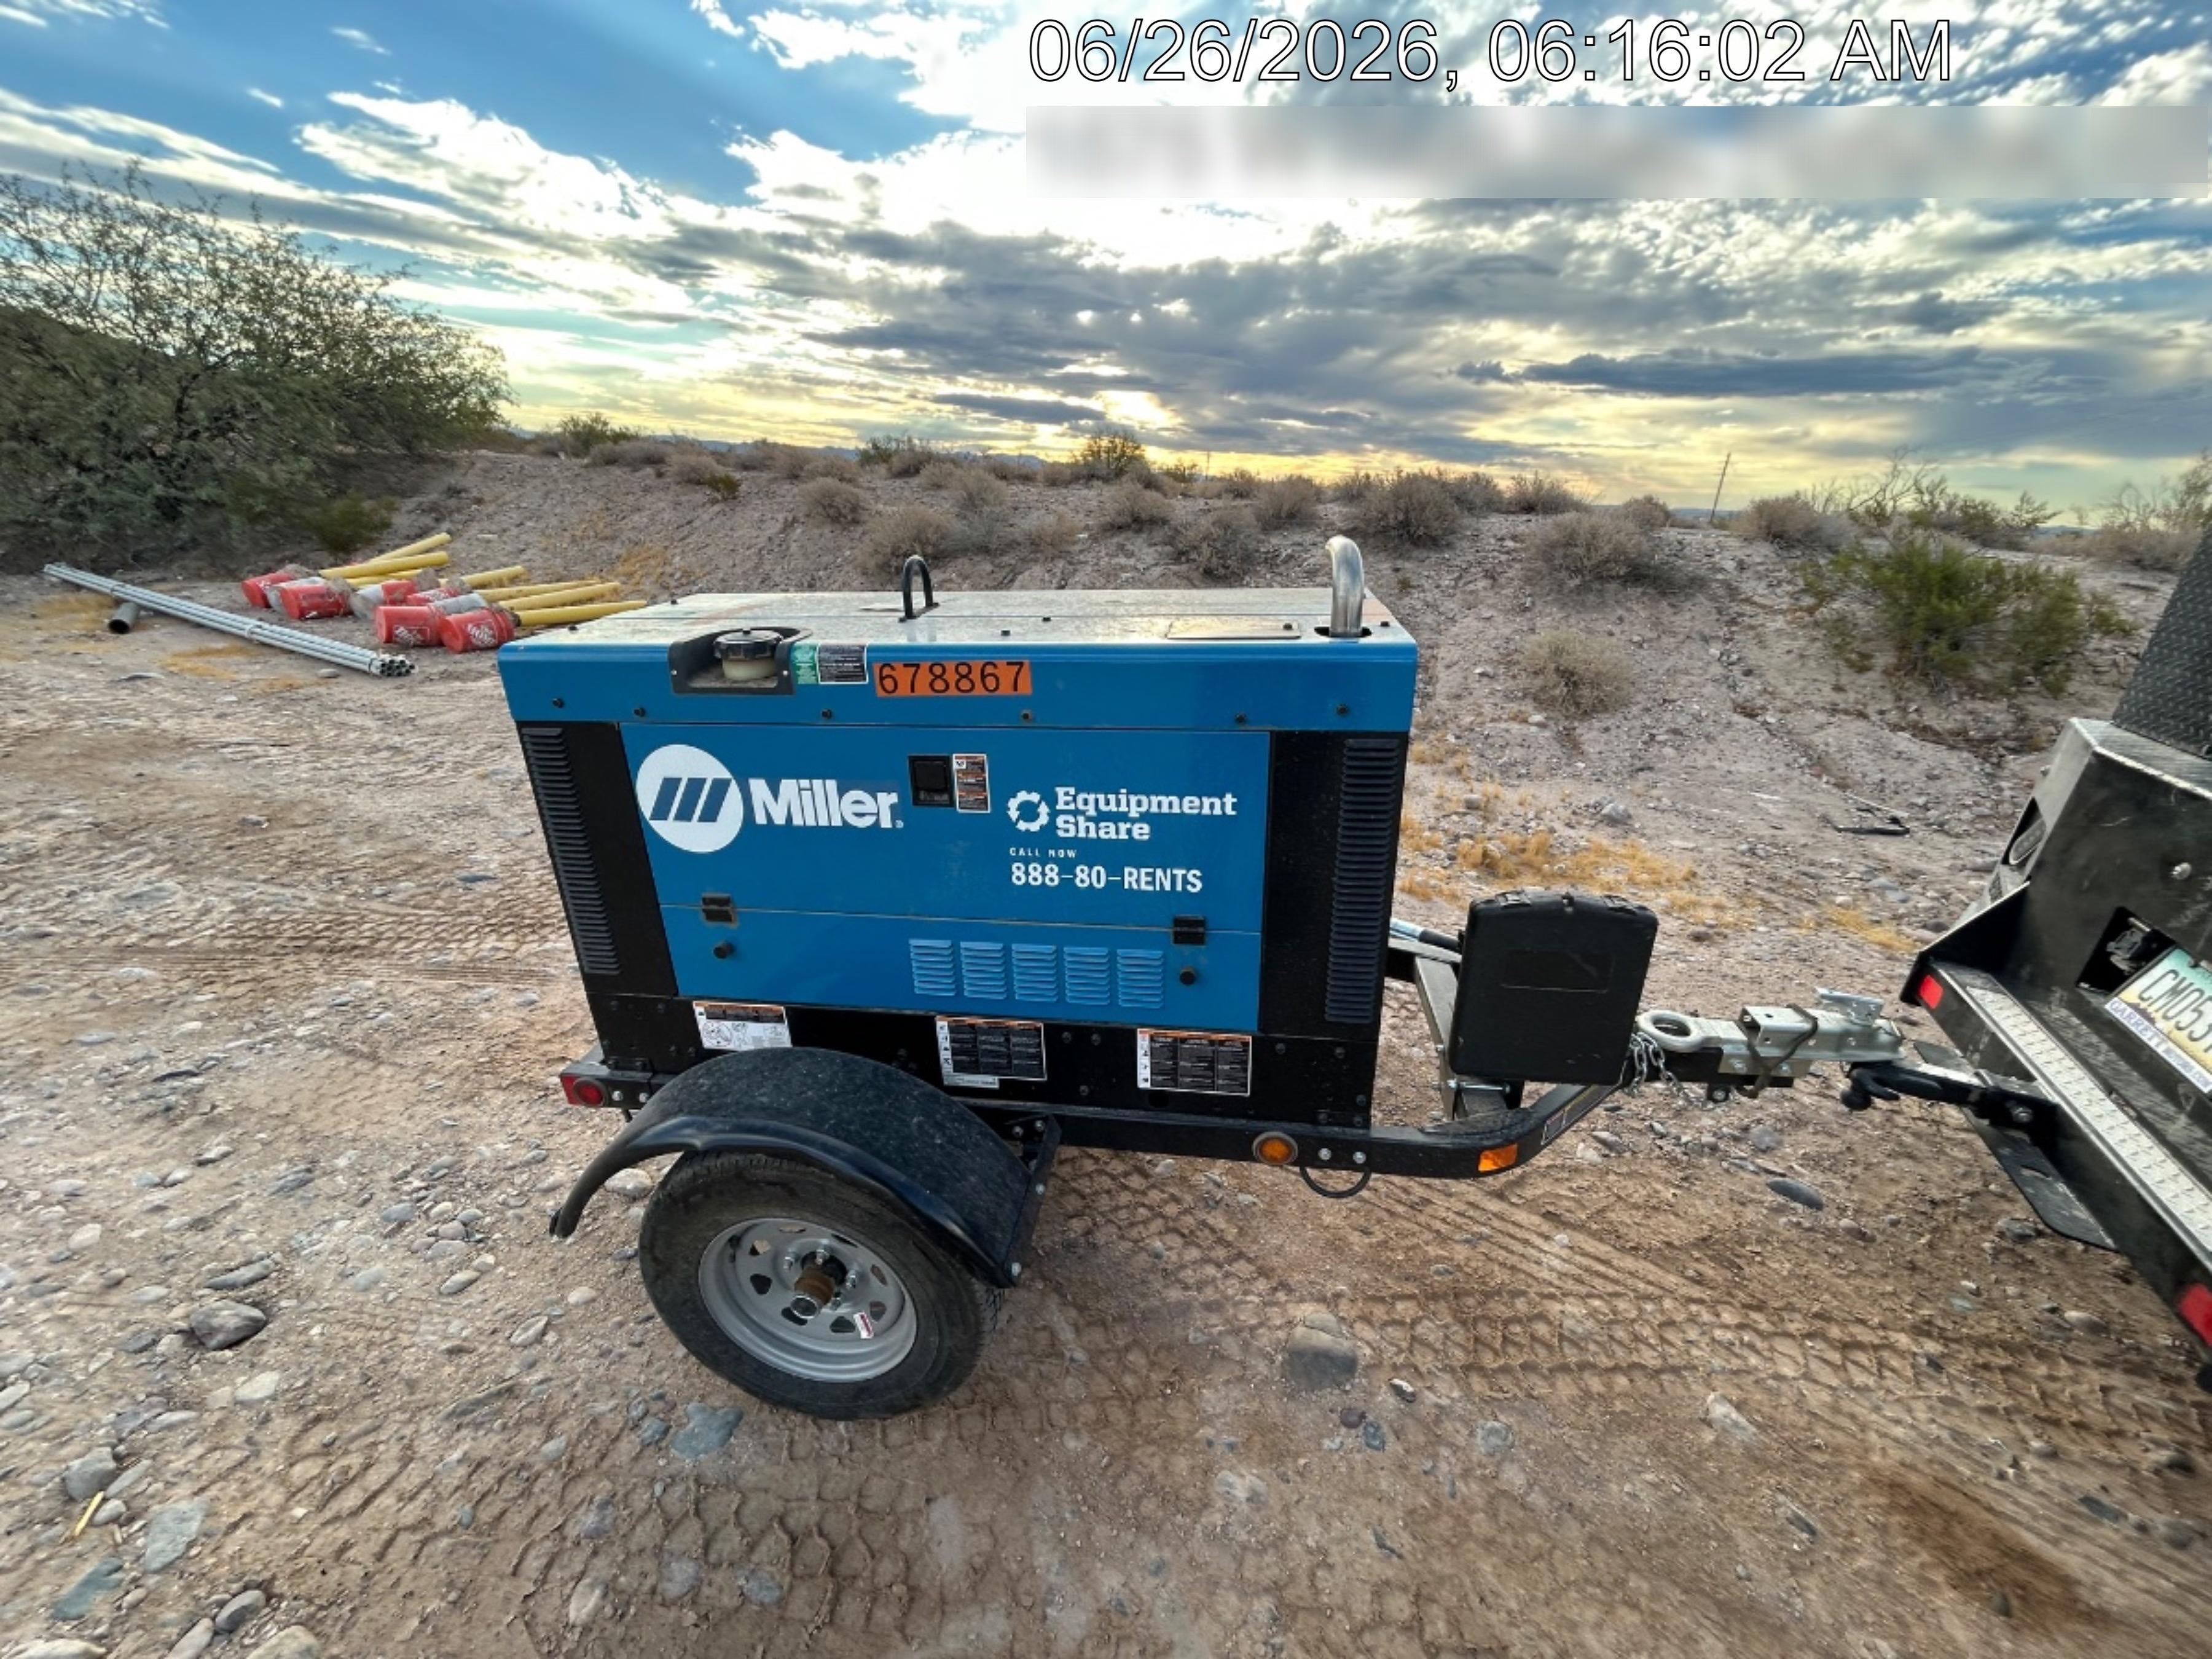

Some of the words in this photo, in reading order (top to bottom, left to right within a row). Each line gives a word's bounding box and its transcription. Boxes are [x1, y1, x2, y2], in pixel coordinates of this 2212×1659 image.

[878, 661, 1024, 694] 678867
[748, 778, 899, 828] Miller
[1055, 786, 1237, 817] Equipment
[1056, 814, 1151, 841] Share
[1010, 847, 1040, 857] CALL
[1048, 849, 1077, 858] NOW
[1011, 861, 1203, 893] 888-80-RENTS
